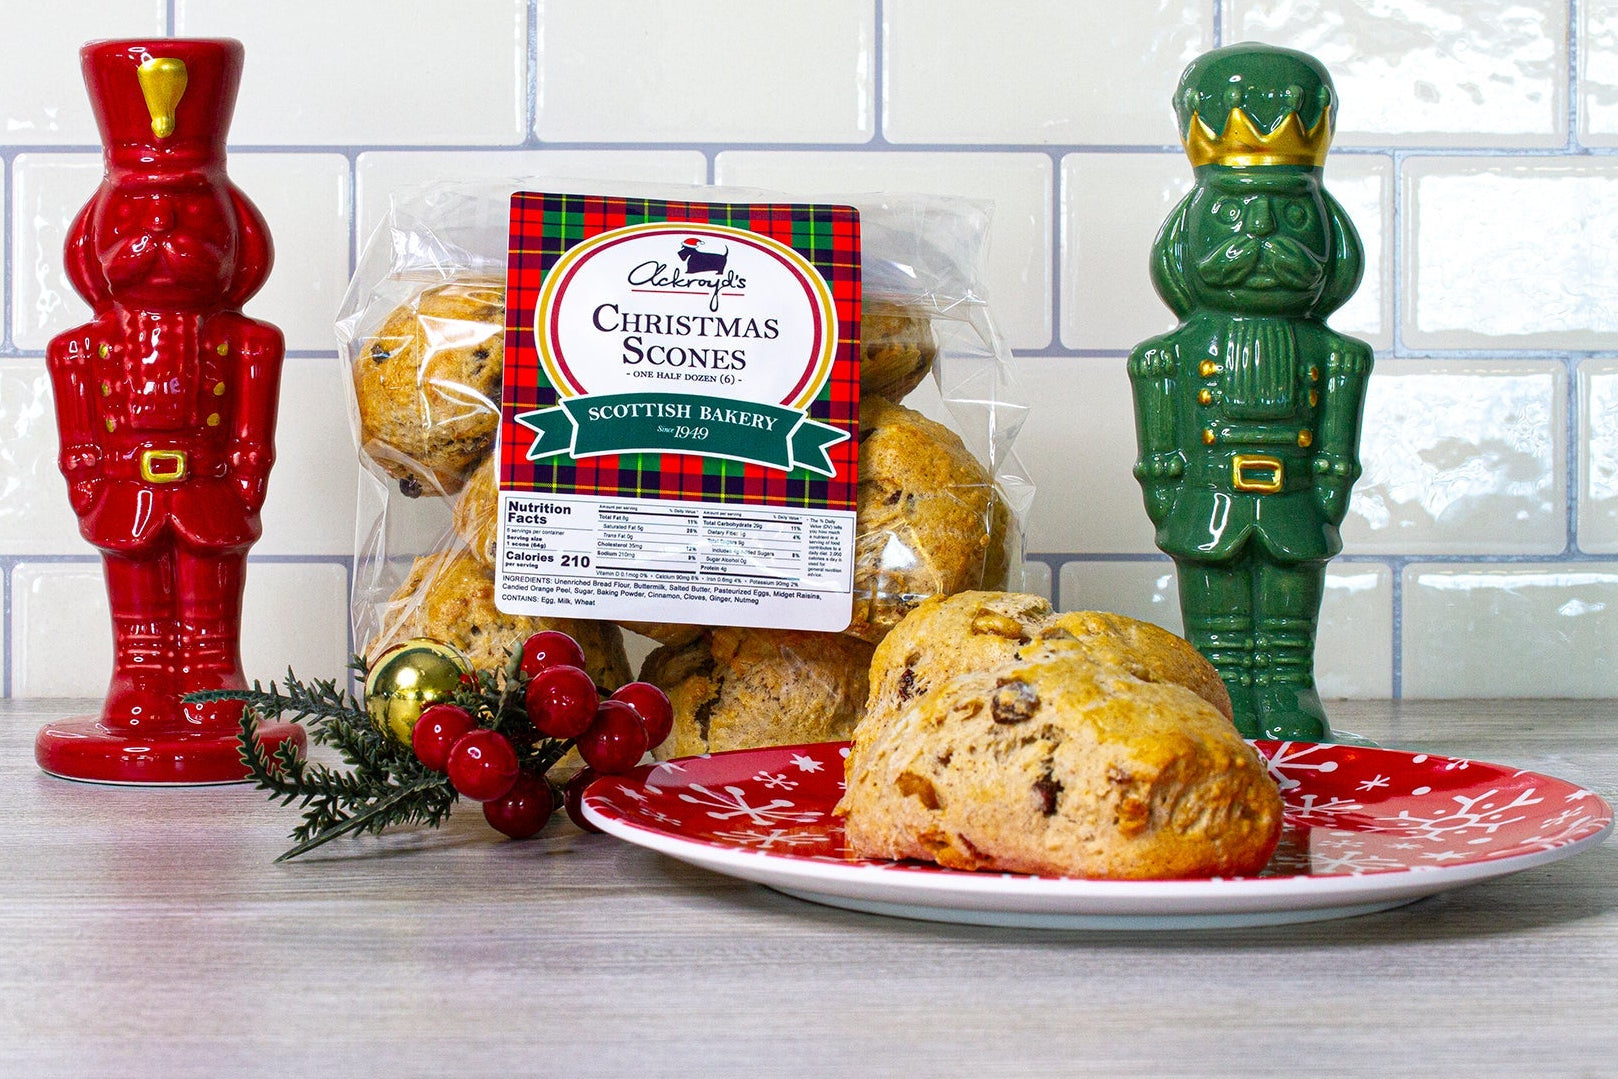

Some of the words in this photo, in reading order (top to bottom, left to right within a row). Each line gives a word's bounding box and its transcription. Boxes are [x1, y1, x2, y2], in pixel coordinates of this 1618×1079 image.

[628, 261, 746, 312] Ackroyd's
[592, 304, 779, 339] CHRISTMAS
[623, 336, 746, 370] SCONES
[633, 371, 652, 379] ONE
[657, 372, 681, 382] HALF
[685, 374, 716, 383] DOZEN
[720, 374, 735, 385] (6)
[588, 404, 691, 421] SCOTTISH
[700, 406, 779, 432] BAKERY
[674, 426, 709, 440] 1949
[508, 501, 571, 514] Nutrition
[508, 512, 547, 524] Facts
[506, 551, 554, 562] Calories
[561, 555, 590, 568] 210
[503, 575, 552, 584] INGREDIENTS:
[709, 595, 732, 603] Ginger,
